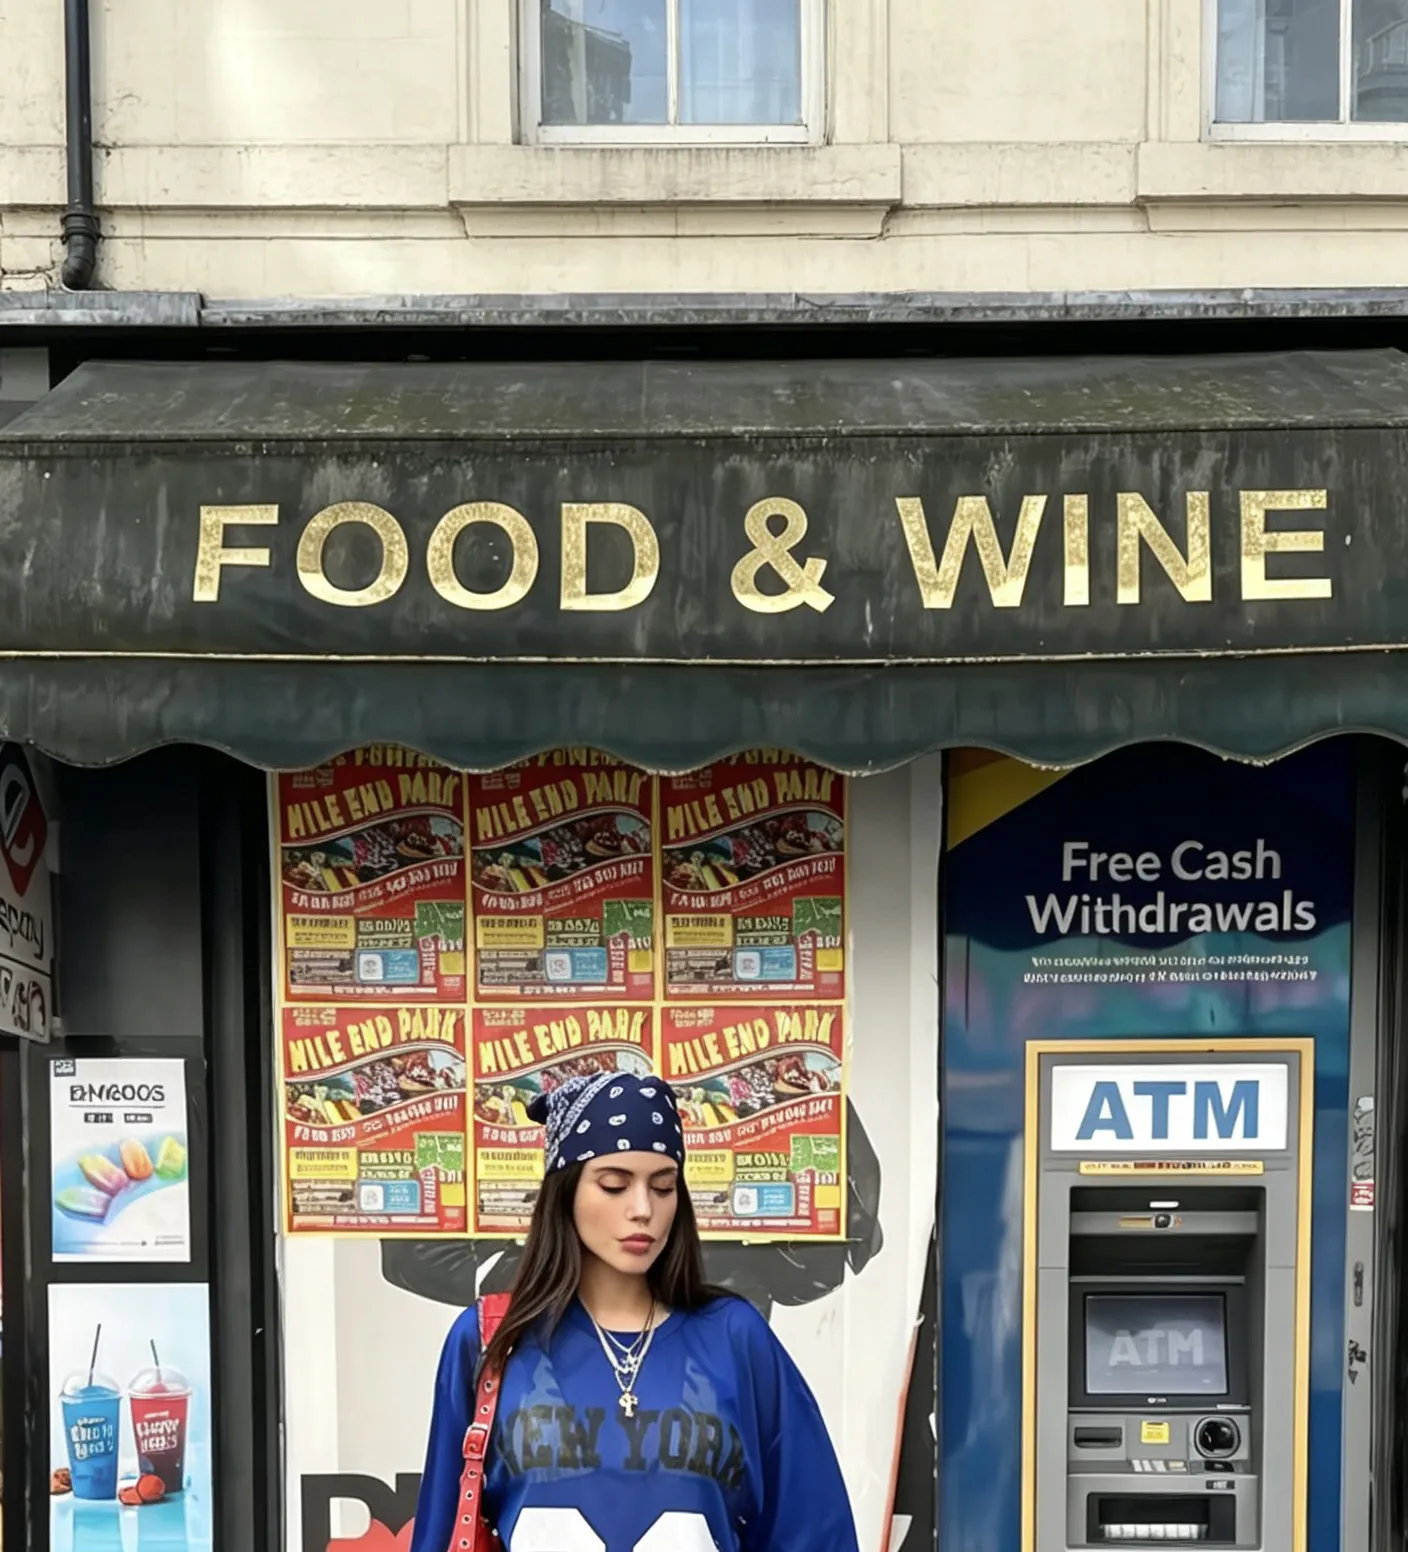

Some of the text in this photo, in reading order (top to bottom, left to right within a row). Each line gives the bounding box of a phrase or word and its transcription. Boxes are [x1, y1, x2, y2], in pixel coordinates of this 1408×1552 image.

[191, 488, 1333, 614] FOOD & WINE
[1061, 838, 1281, 882] Free Cash
[1025, 889, 1317, 934] Withdrawals
[346, 1015, 394, 1057] END
[533, 1015, 583, 1057] END
[722, 1018, 771, 1059] END
[1075, 1079, 1260, 1141] ATM
[1107, 1328, 1204, 1367] ATM
